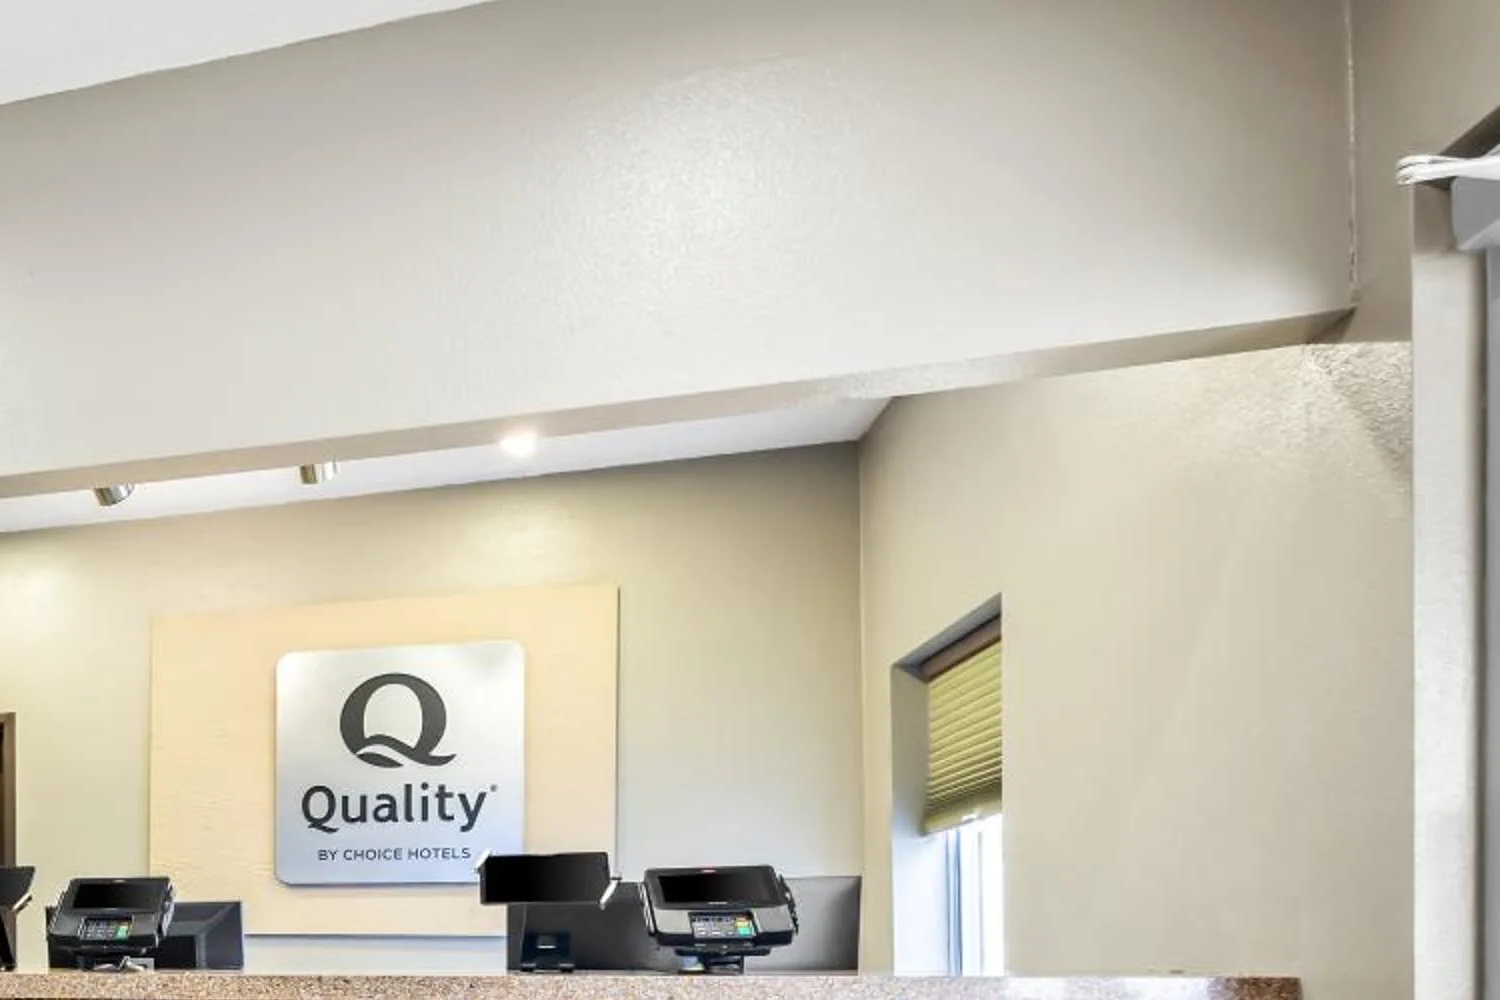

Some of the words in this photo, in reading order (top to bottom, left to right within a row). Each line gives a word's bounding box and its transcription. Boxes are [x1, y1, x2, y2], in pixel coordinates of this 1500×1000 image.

[340, 672, 456, 768] Q
[301, 782, 487, 833] Quality
[317, 849, 338, 861] BY
[343, 848, 403, 861] CHOICE
[407, 847, 472, 860] HOTELS
